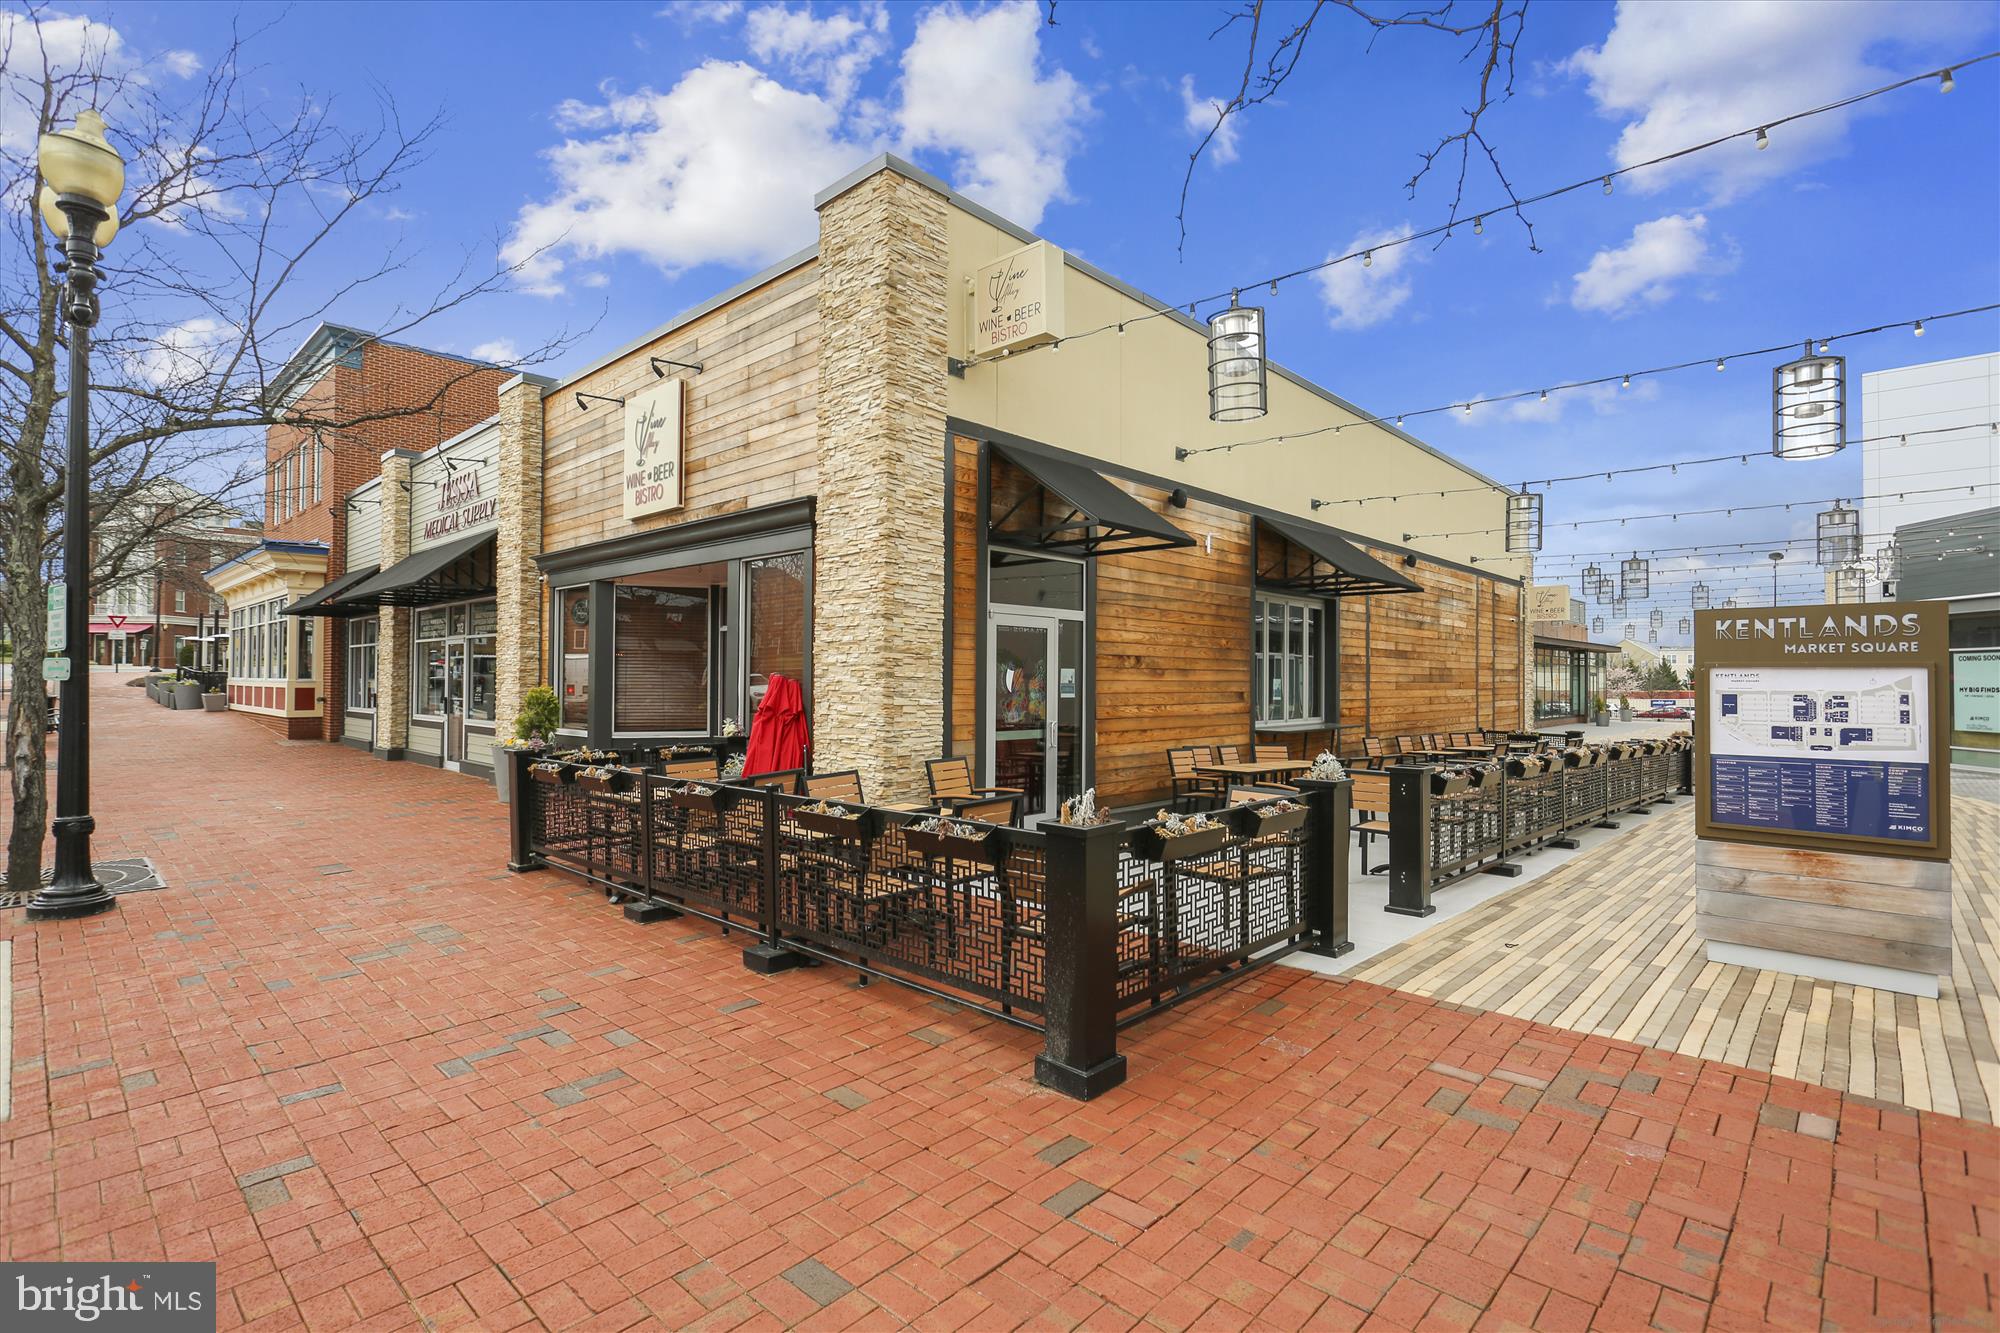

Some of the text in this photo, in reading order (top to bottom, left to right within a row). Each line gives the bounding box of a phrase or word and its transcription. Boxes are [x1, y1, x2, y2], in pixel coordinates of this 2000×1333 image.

[979, 301, 1041, 333] WINE BEER
[991, 321, 1028, 344] BISTRO
[626, 461, 675, 490] WINE BEER
[438, 470, 481, 512] JASSA
[635, 483, 664, 506] BISTRO
[424, 498, 497, 540] MEDICAL SUPPLY
[1715, 613, 1921, 640] KENTLANDS
[1784, 641, 1919, 654] MARKET SQUARE
